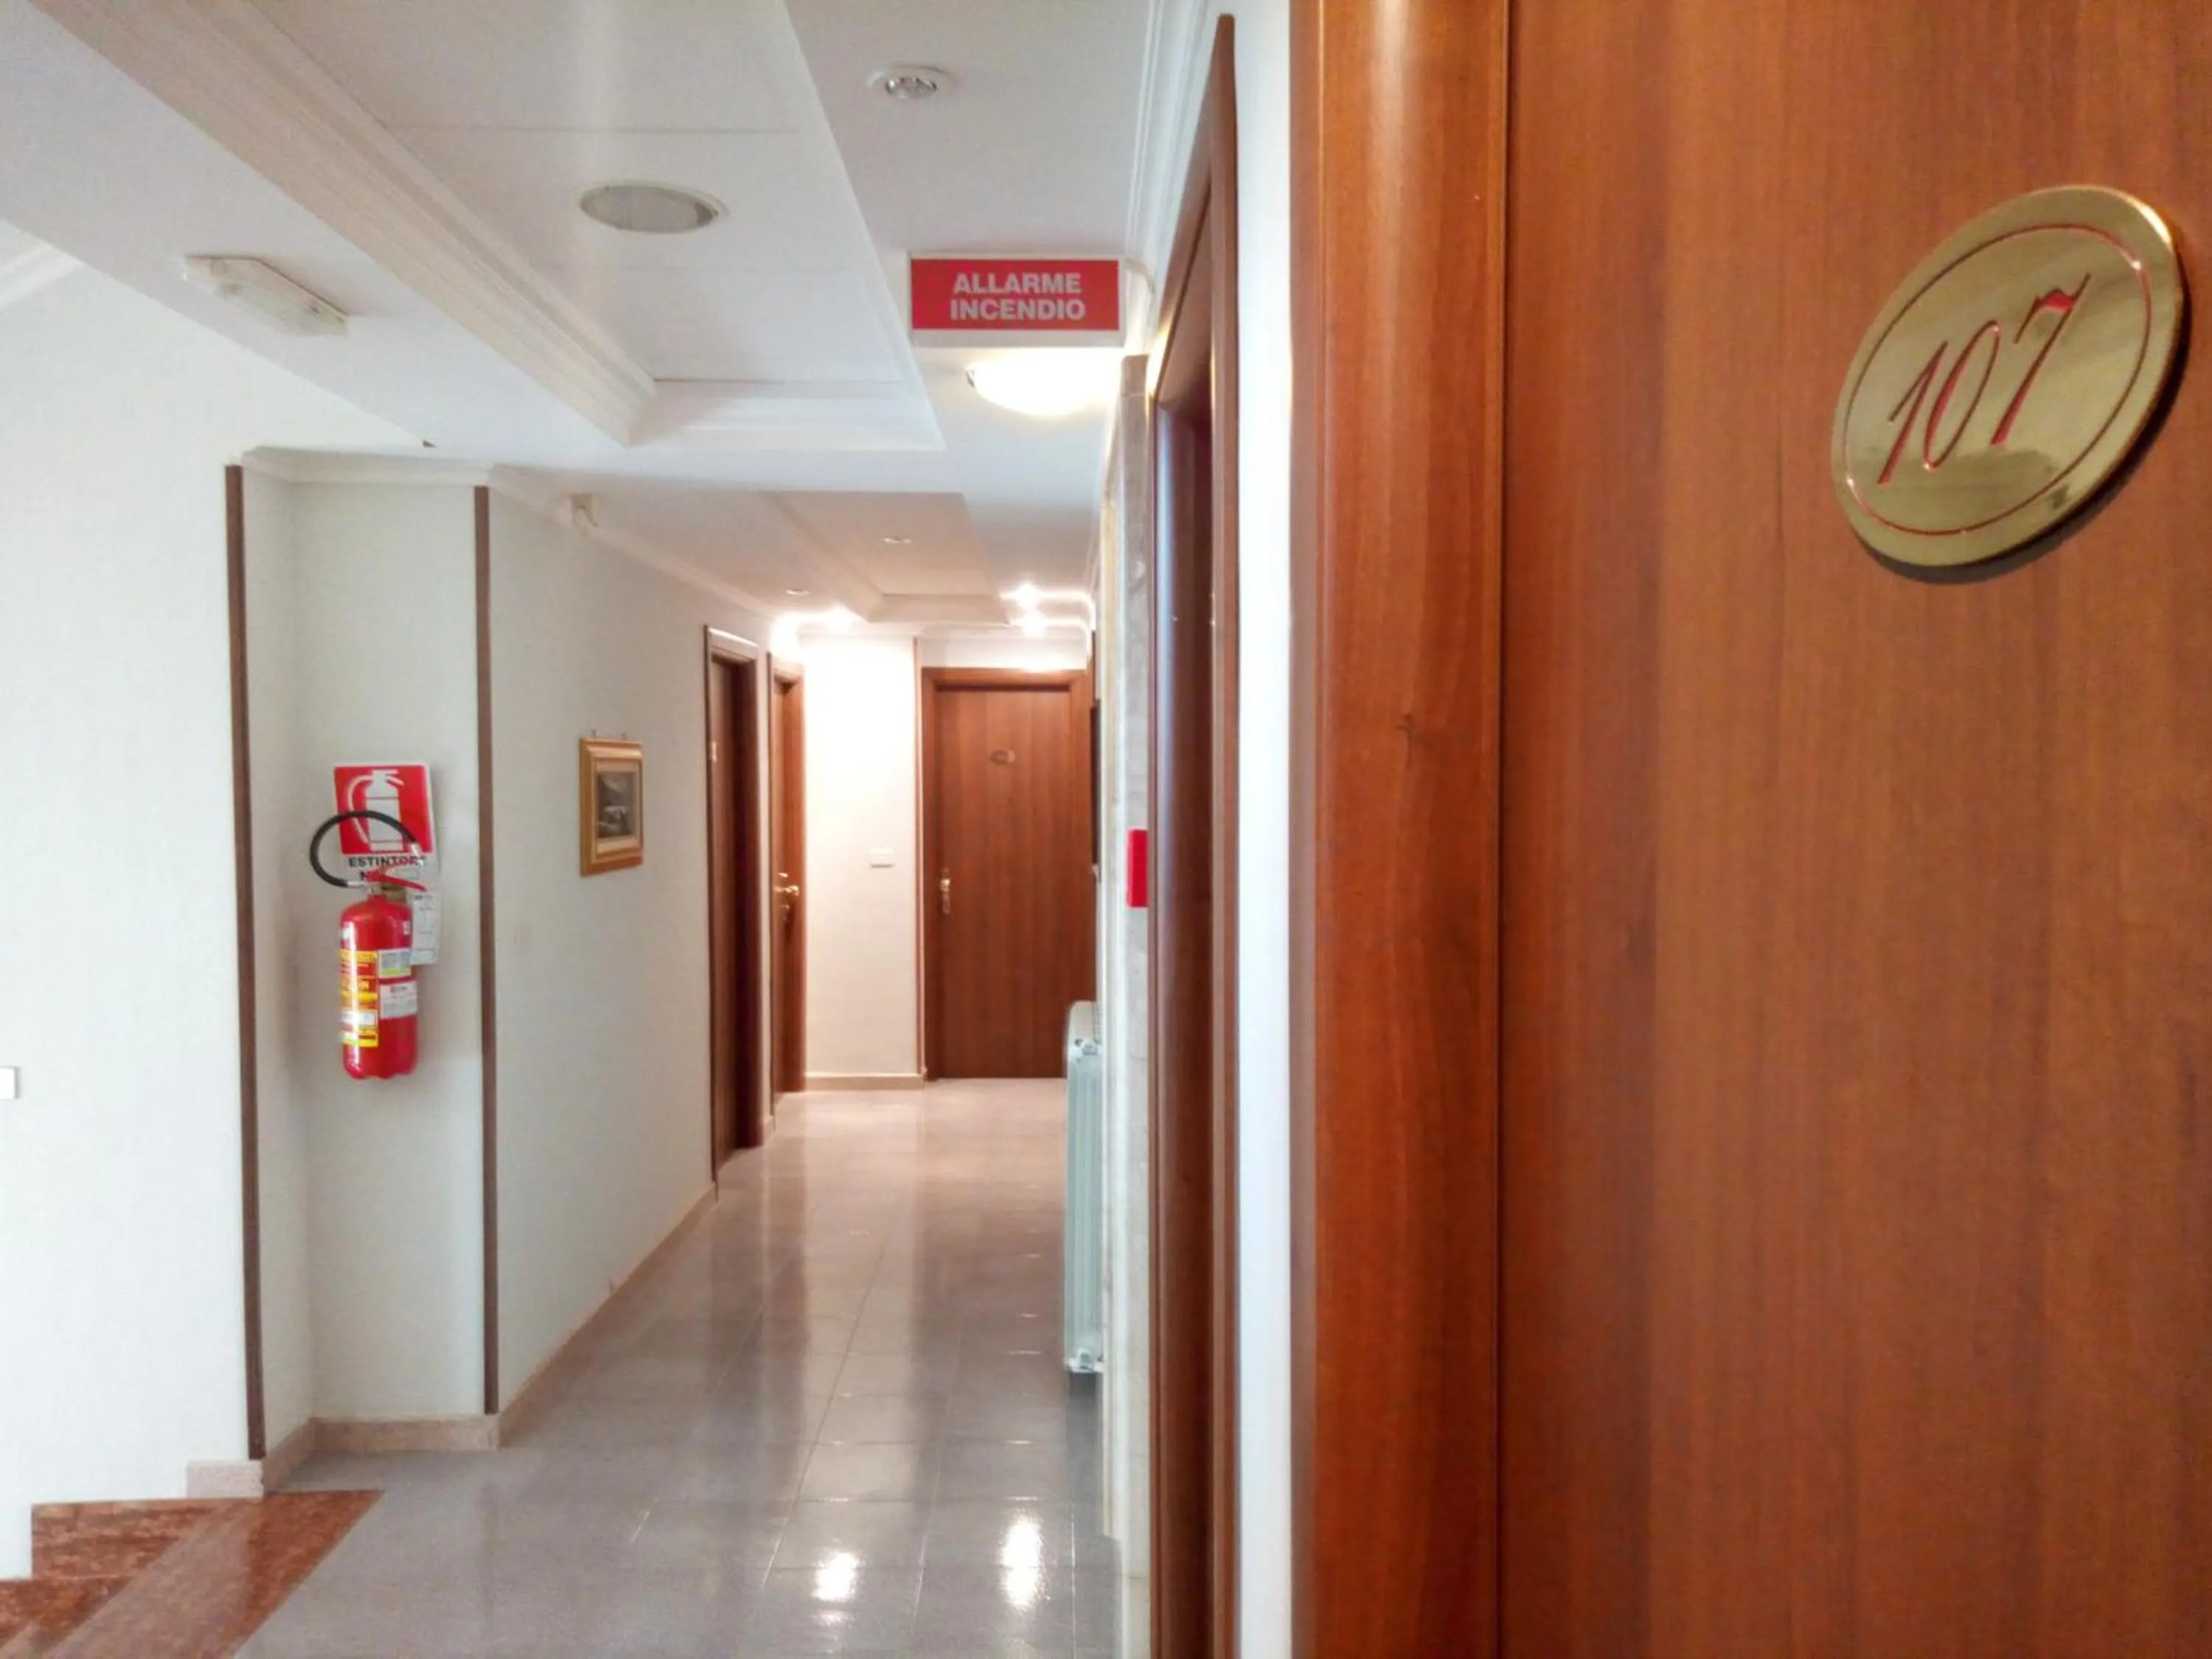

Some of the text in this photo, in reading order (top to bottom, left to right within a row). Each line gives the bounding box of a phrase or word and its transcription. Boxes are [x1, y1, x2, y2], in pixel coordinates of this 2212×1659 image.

[953, 272, 1082, 293] ALLARME
[950, 299, 1086, 320] INCENDIO
[1877, 272, 2092, 484] 107
